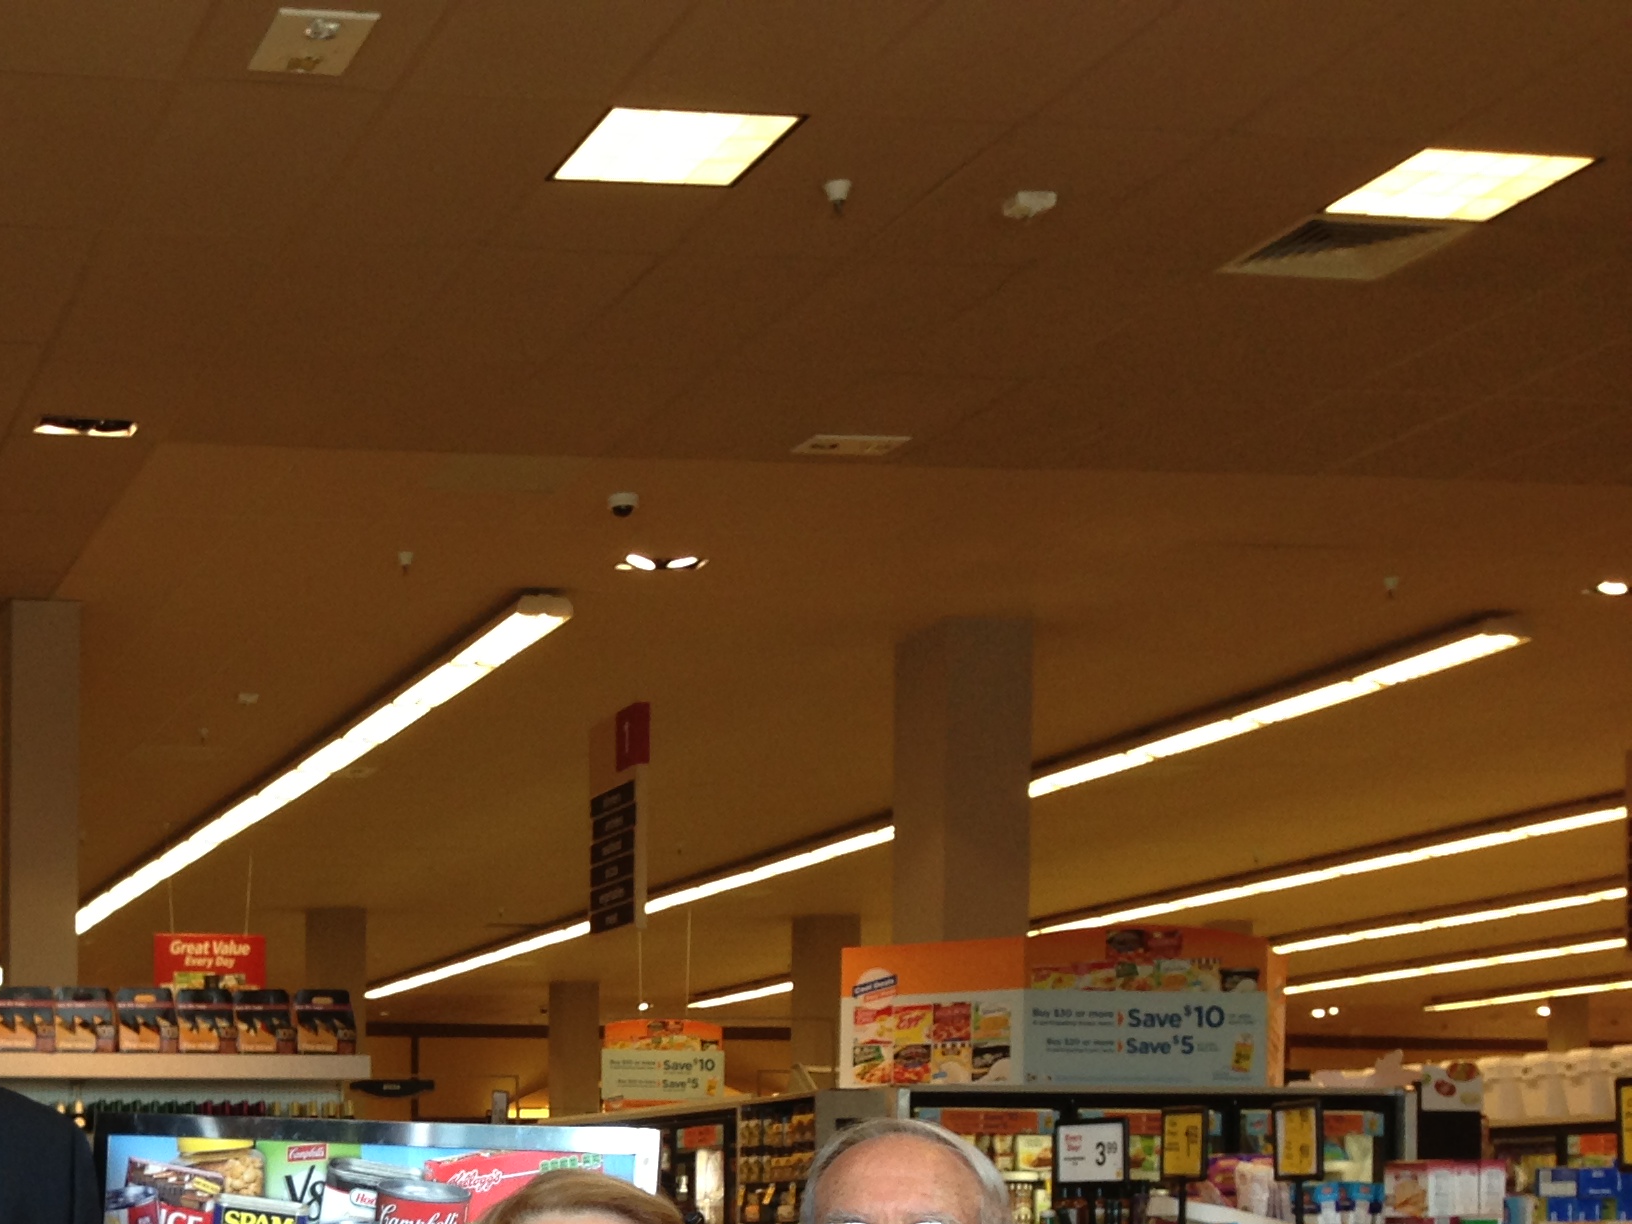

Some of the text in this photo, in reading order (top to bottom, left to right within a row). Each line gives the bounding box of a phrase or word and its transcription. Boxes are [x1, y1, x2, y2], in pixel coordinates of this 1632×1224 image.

[169, 940, 250, 956] Great Value
[184, 956, 236, 969] Every Day
[1128, 1008, 1182, 1028] Save
[1184, 1004, 1225, 1028] $10
[1127, 1037, 1172, 1055] Save
[1173, 1034, 1194, 1055] $5
[663, 1059, 693, 1071] Save
[662, 1079, 687, 1089] Save
